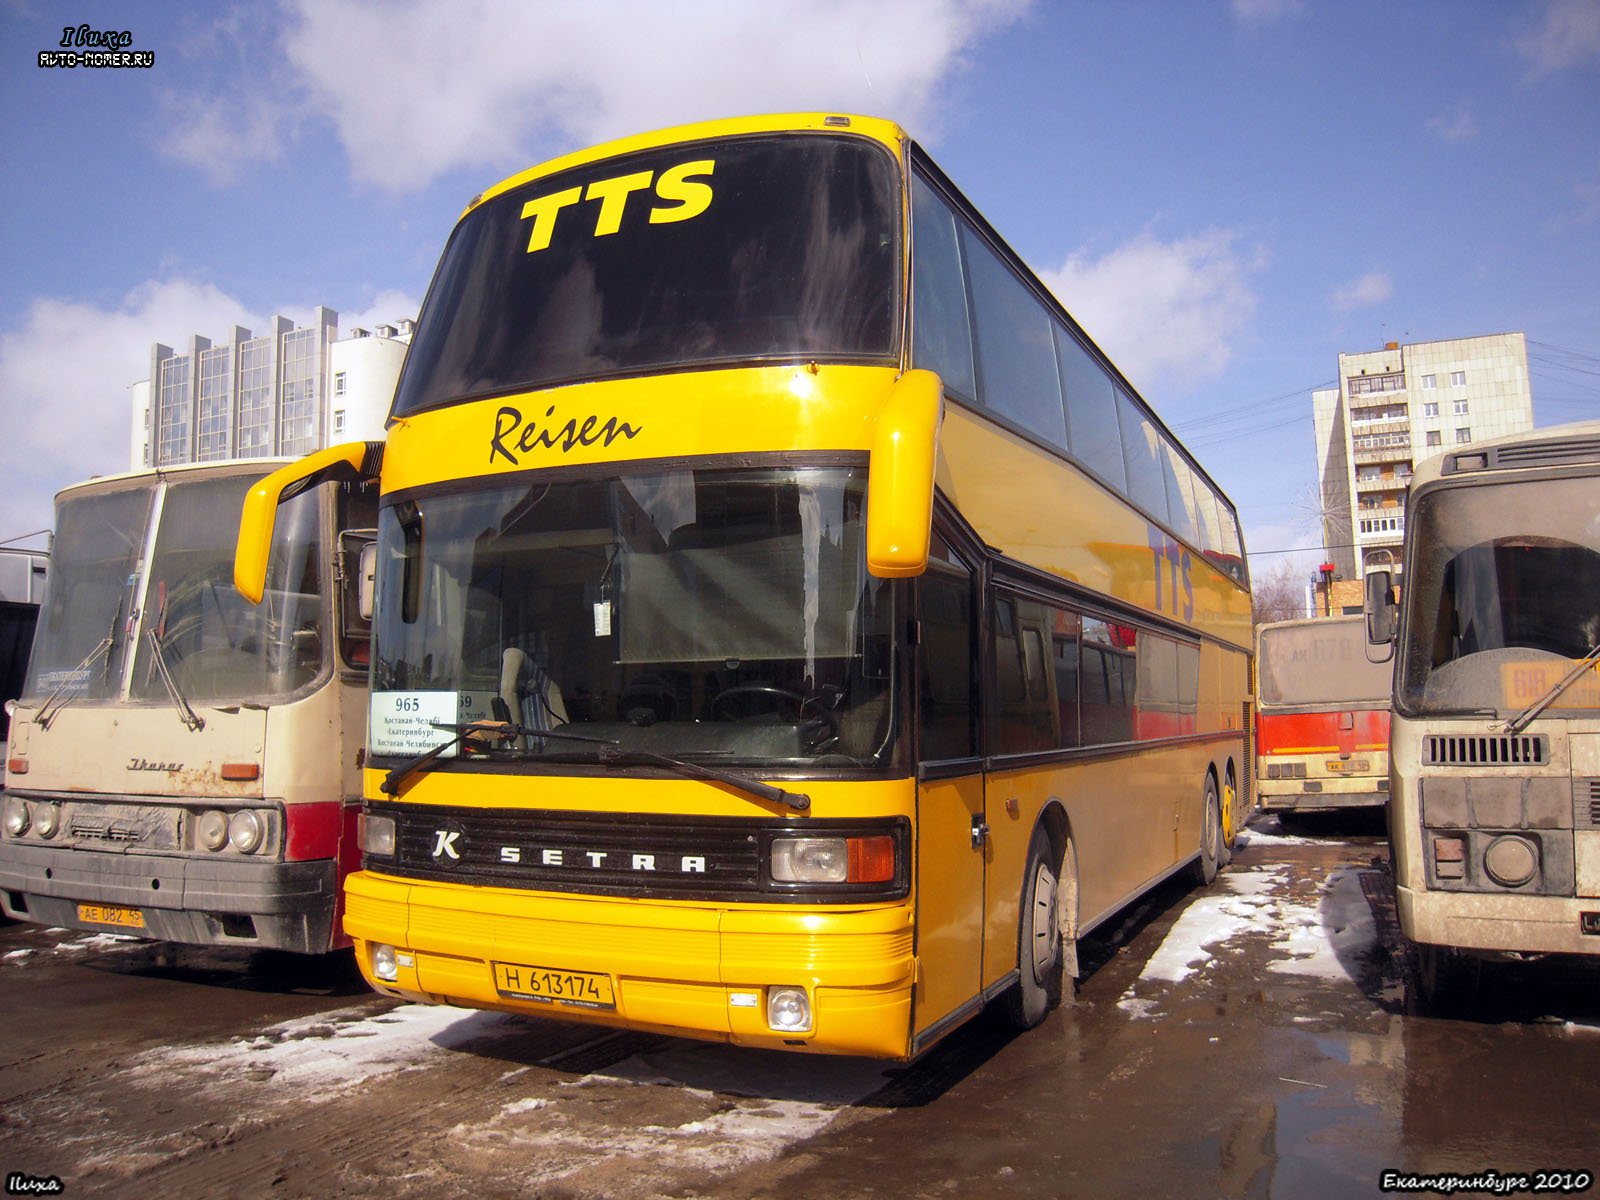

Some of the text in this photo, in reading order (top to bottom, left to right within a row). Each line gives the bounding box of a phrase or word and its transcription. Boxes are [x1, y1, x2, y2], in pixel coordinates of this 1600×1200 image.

[520, 159, 716, 253] TTS
[489, 405, 643, 466] Reisen
[1147, 522, 1194, 624] TTS
[395, 697, 420, 712] 965
[500, 846, 706, 874] SETRA
[530, 971, 600, 999] 613174
